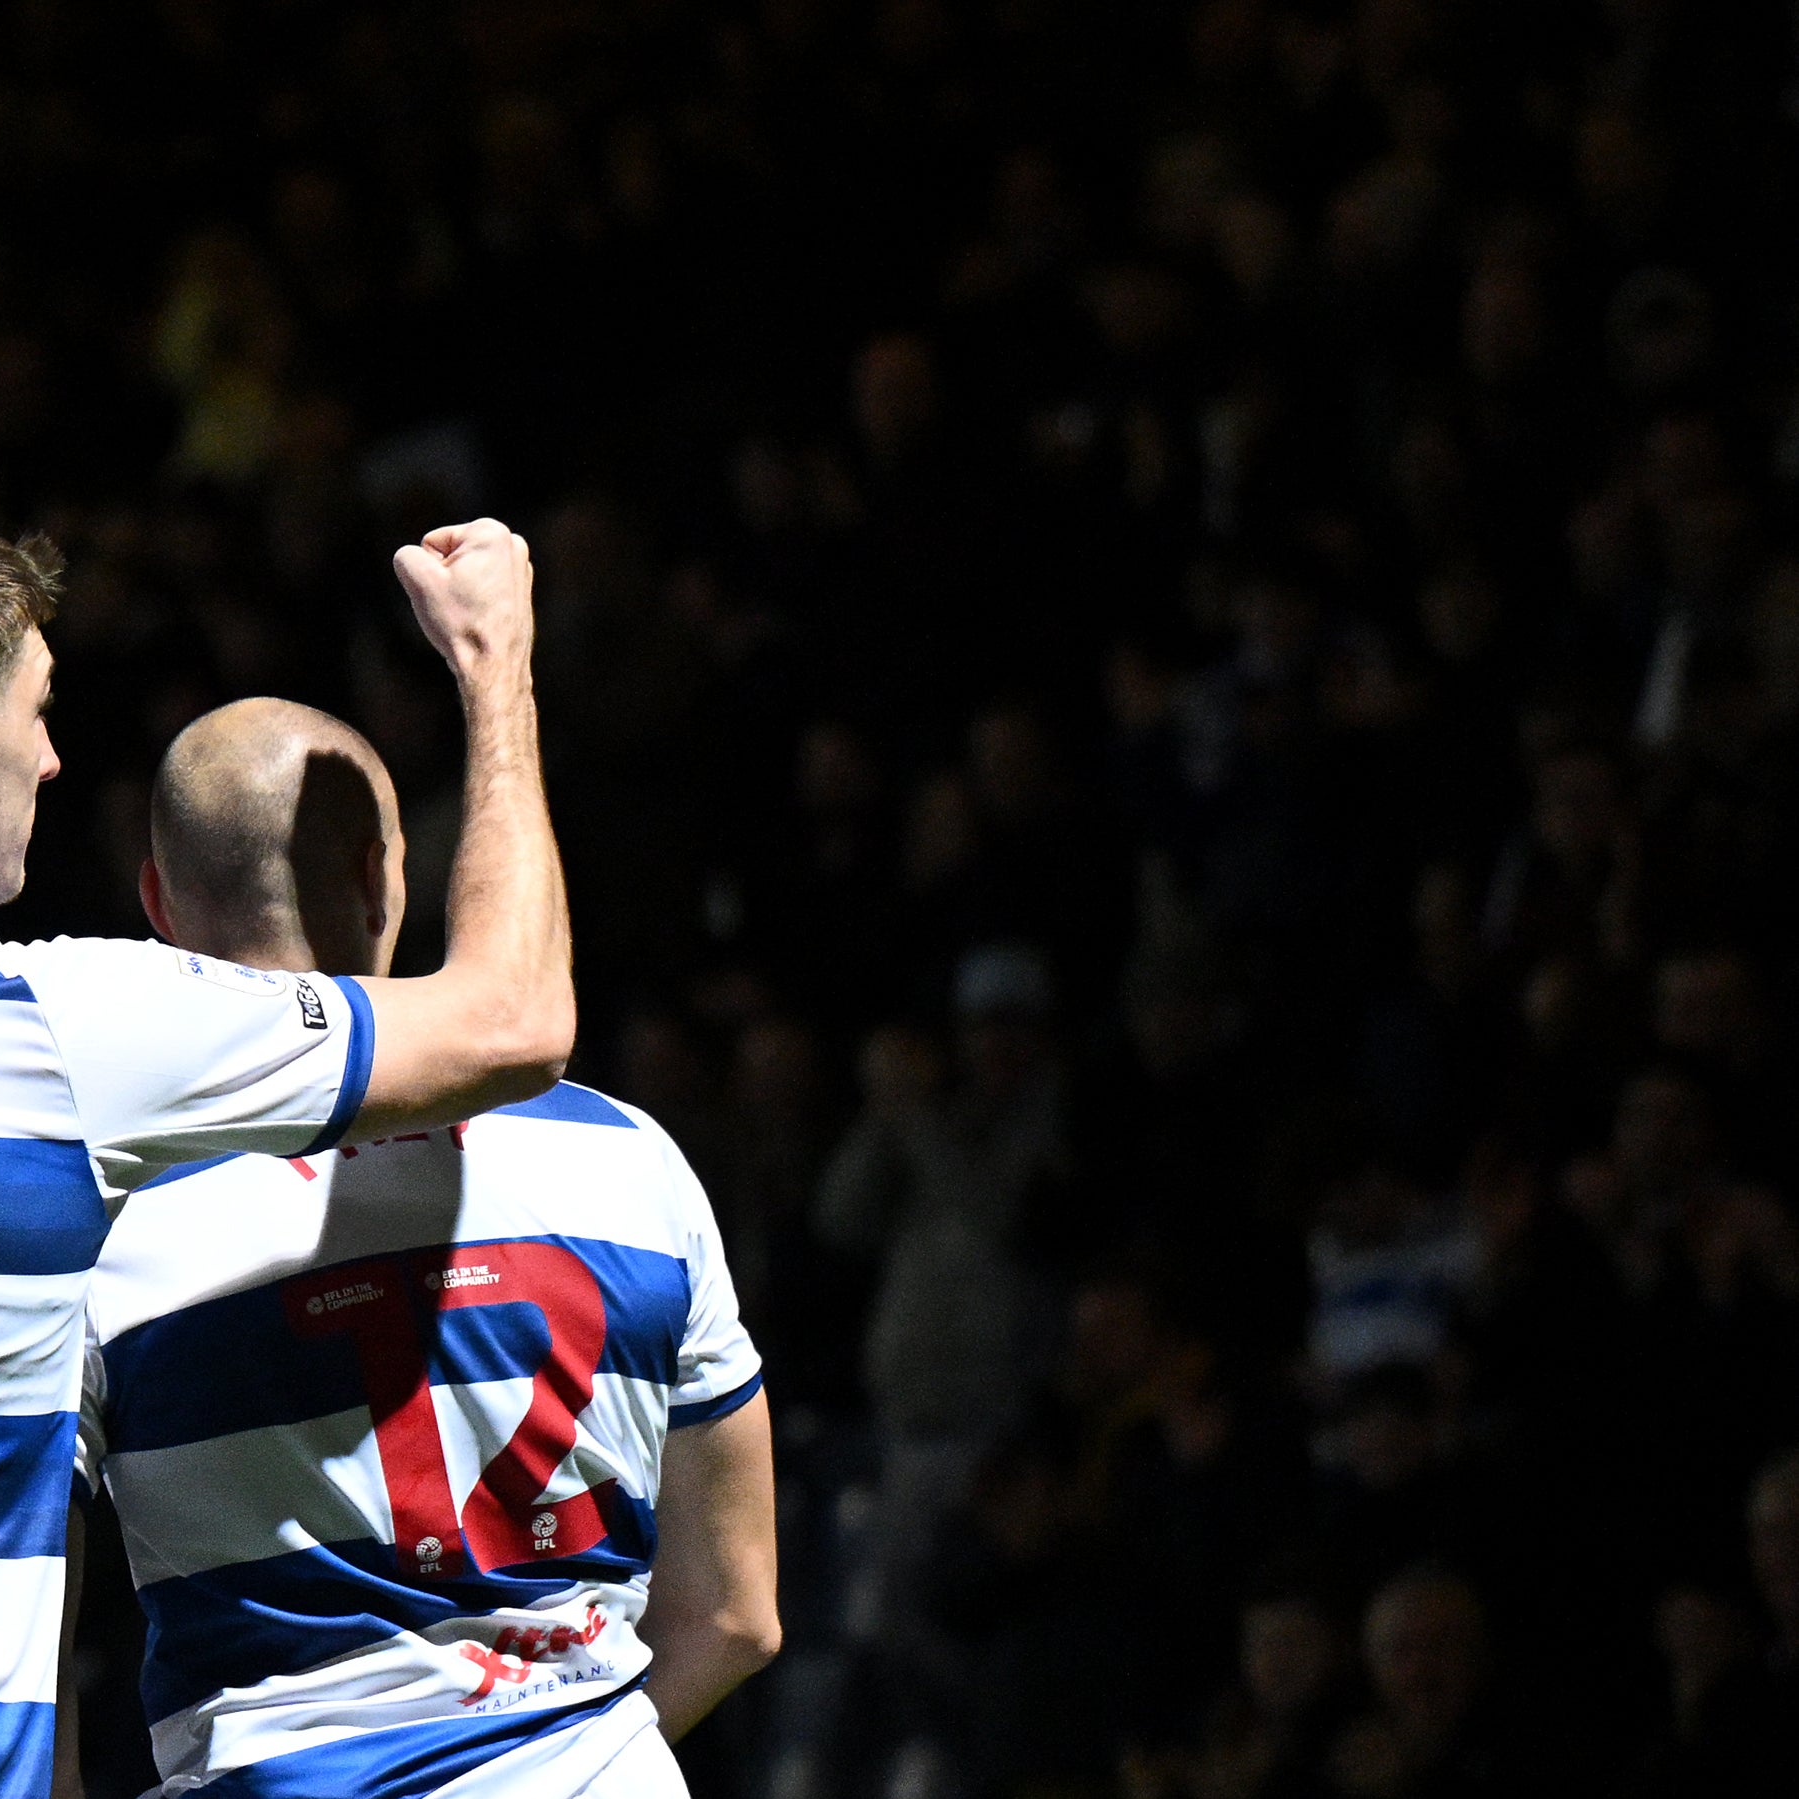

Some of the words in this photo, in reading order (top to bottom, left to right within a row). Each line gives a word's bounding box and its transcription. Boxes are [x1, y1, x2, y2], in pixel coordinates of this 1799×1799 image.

[442, 1269, 459, 1280] EFL
[471, 1265, 489, 1276] THE
[443, 1273, 500, 1289] COMMUNITY
[282, 1241, 617, 1577] 12
[534, 1539, 556, 1550] EFL
[419, 1561, 442, 1573] EFL
[475, 1659, 616, 1714] MAINTENANC
